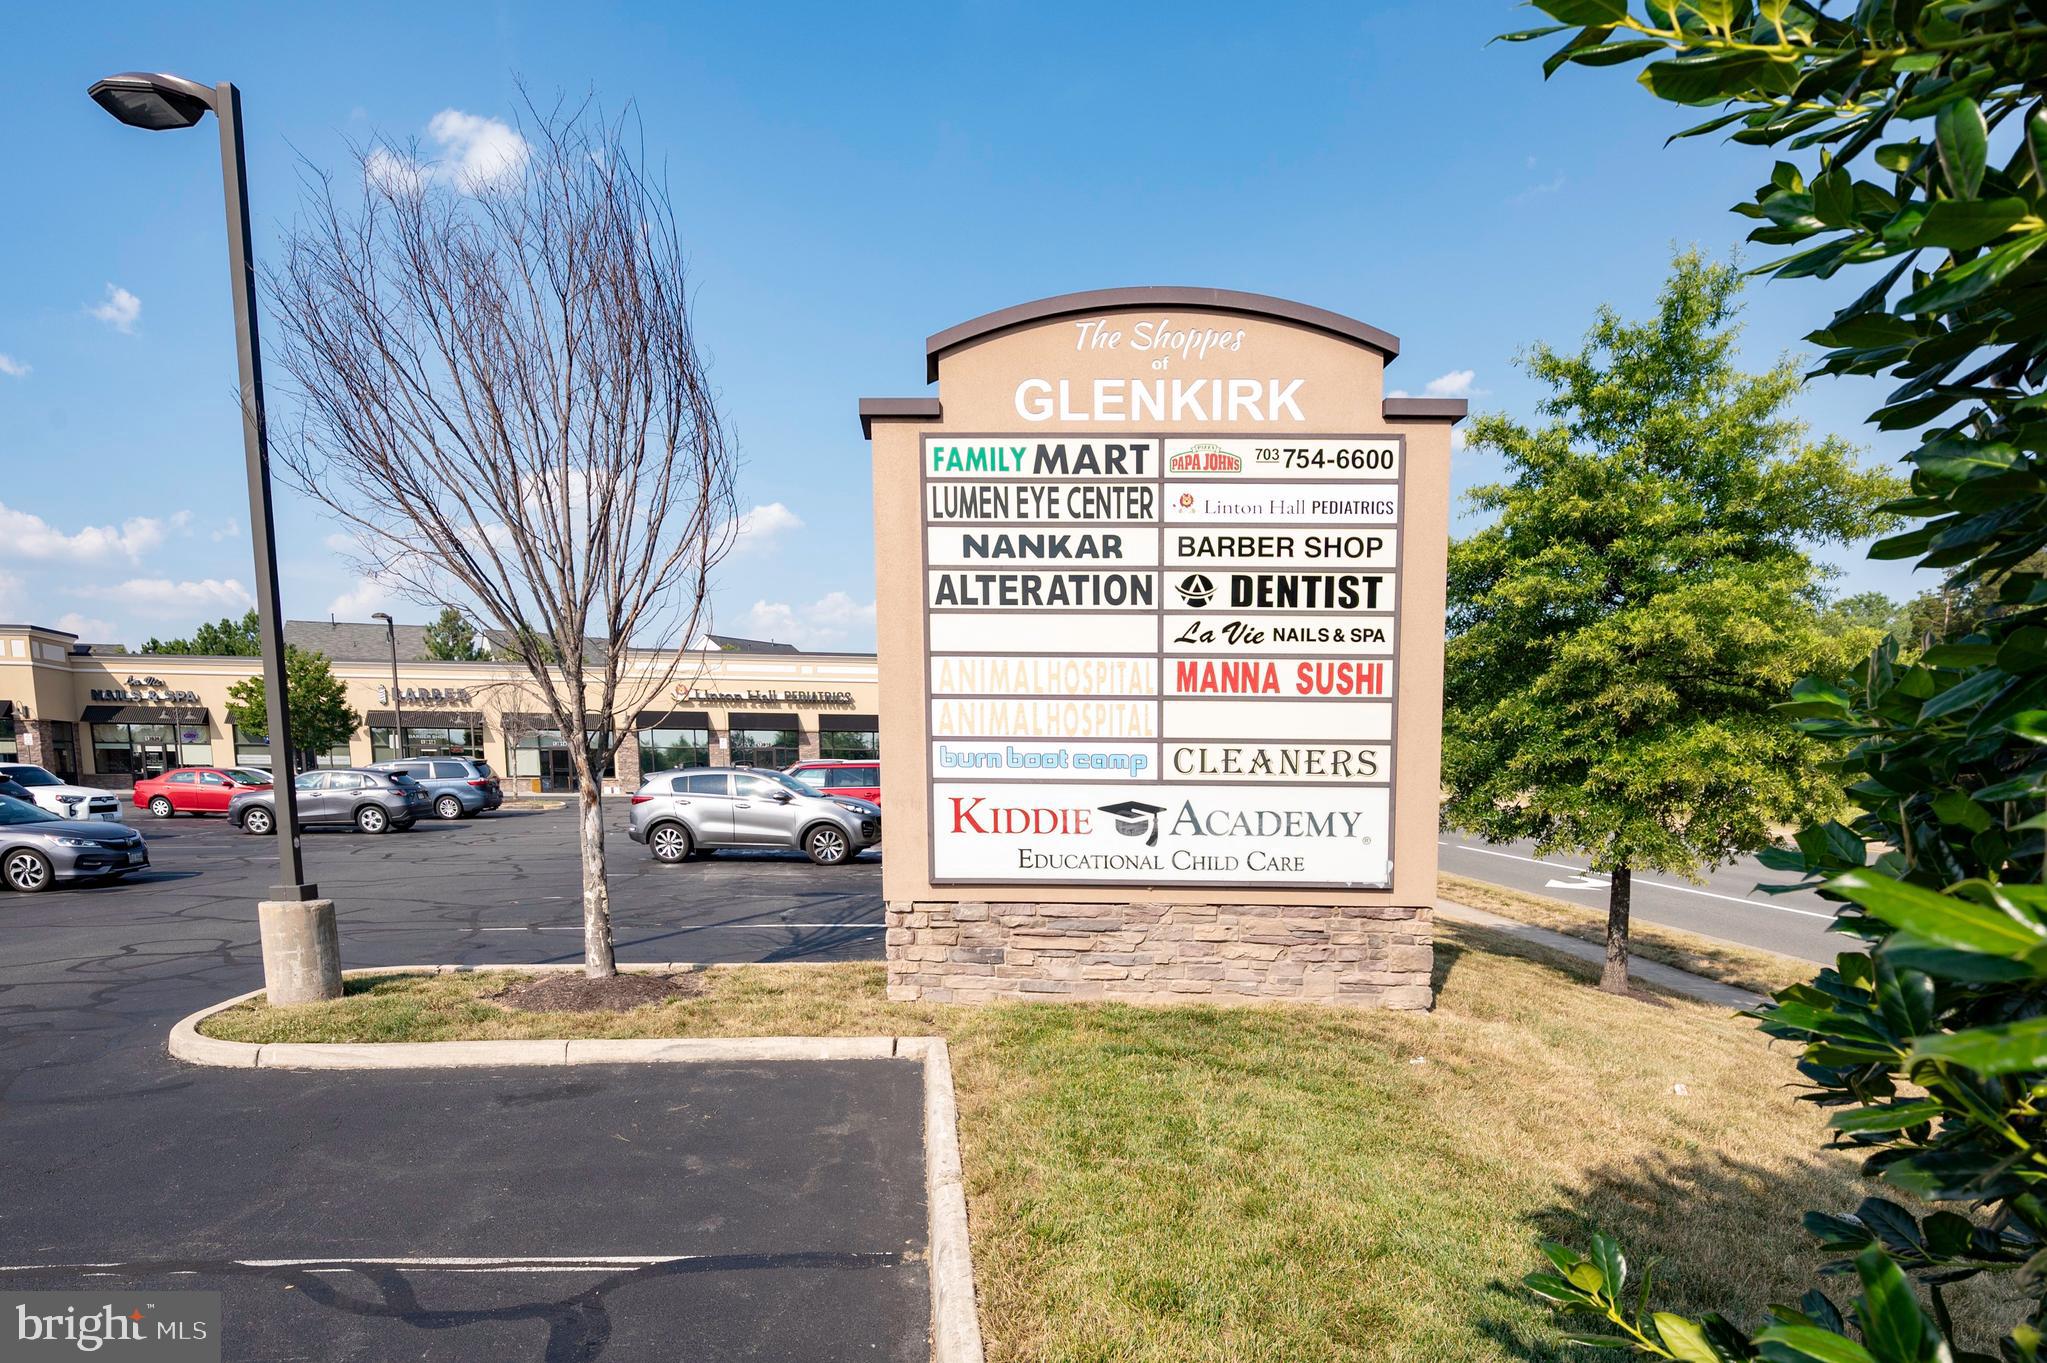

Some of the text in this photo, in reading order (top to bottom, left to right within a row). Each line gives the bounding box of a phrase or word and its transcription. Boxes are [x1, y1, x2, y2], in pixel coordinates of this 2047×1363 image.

[1075, 319, 1246, 360] The Shoppes
[1151, 355, 1170, 370] of
[1014, 378, 1306, 422] GLENKIRK
[933, 444, 1150, 475] FAMILY MART
[1172, 454, 1201, 471] PAPA
[1255, 448, 1394, 470] 703 754-6600
[932, 485, 1154, 520] LUMEN EYE CENTER
[1204, 500, 1394, 515] Linton Hall PEDIATRICS
[962, 534, 1123, 559] NANKAR
[1178, 536, 1383, 558] BARBER SHOP
[935, 574, 1153, 606] ALTERATION
[1231, 574, 1383, 609] DENTIST
[1174, 620, 1386, 645] La Vie NAILS & SPA
[1176, 661, 1384, 695] MANNA SUSHI
[91, 689, 197, 703] NAILS & SPA
[694, 688, 853, 705] Linton Hall PEDIATRICS
[940, 745, 1148, 778] burn boot camp
[1173, 747, 1378, 778] CLEANERS
[948, 797, 1363, 838] KIDDIE ACADEMY
[1018, 848, 1305, 872] EDUCATIONAL CHILD CARE
